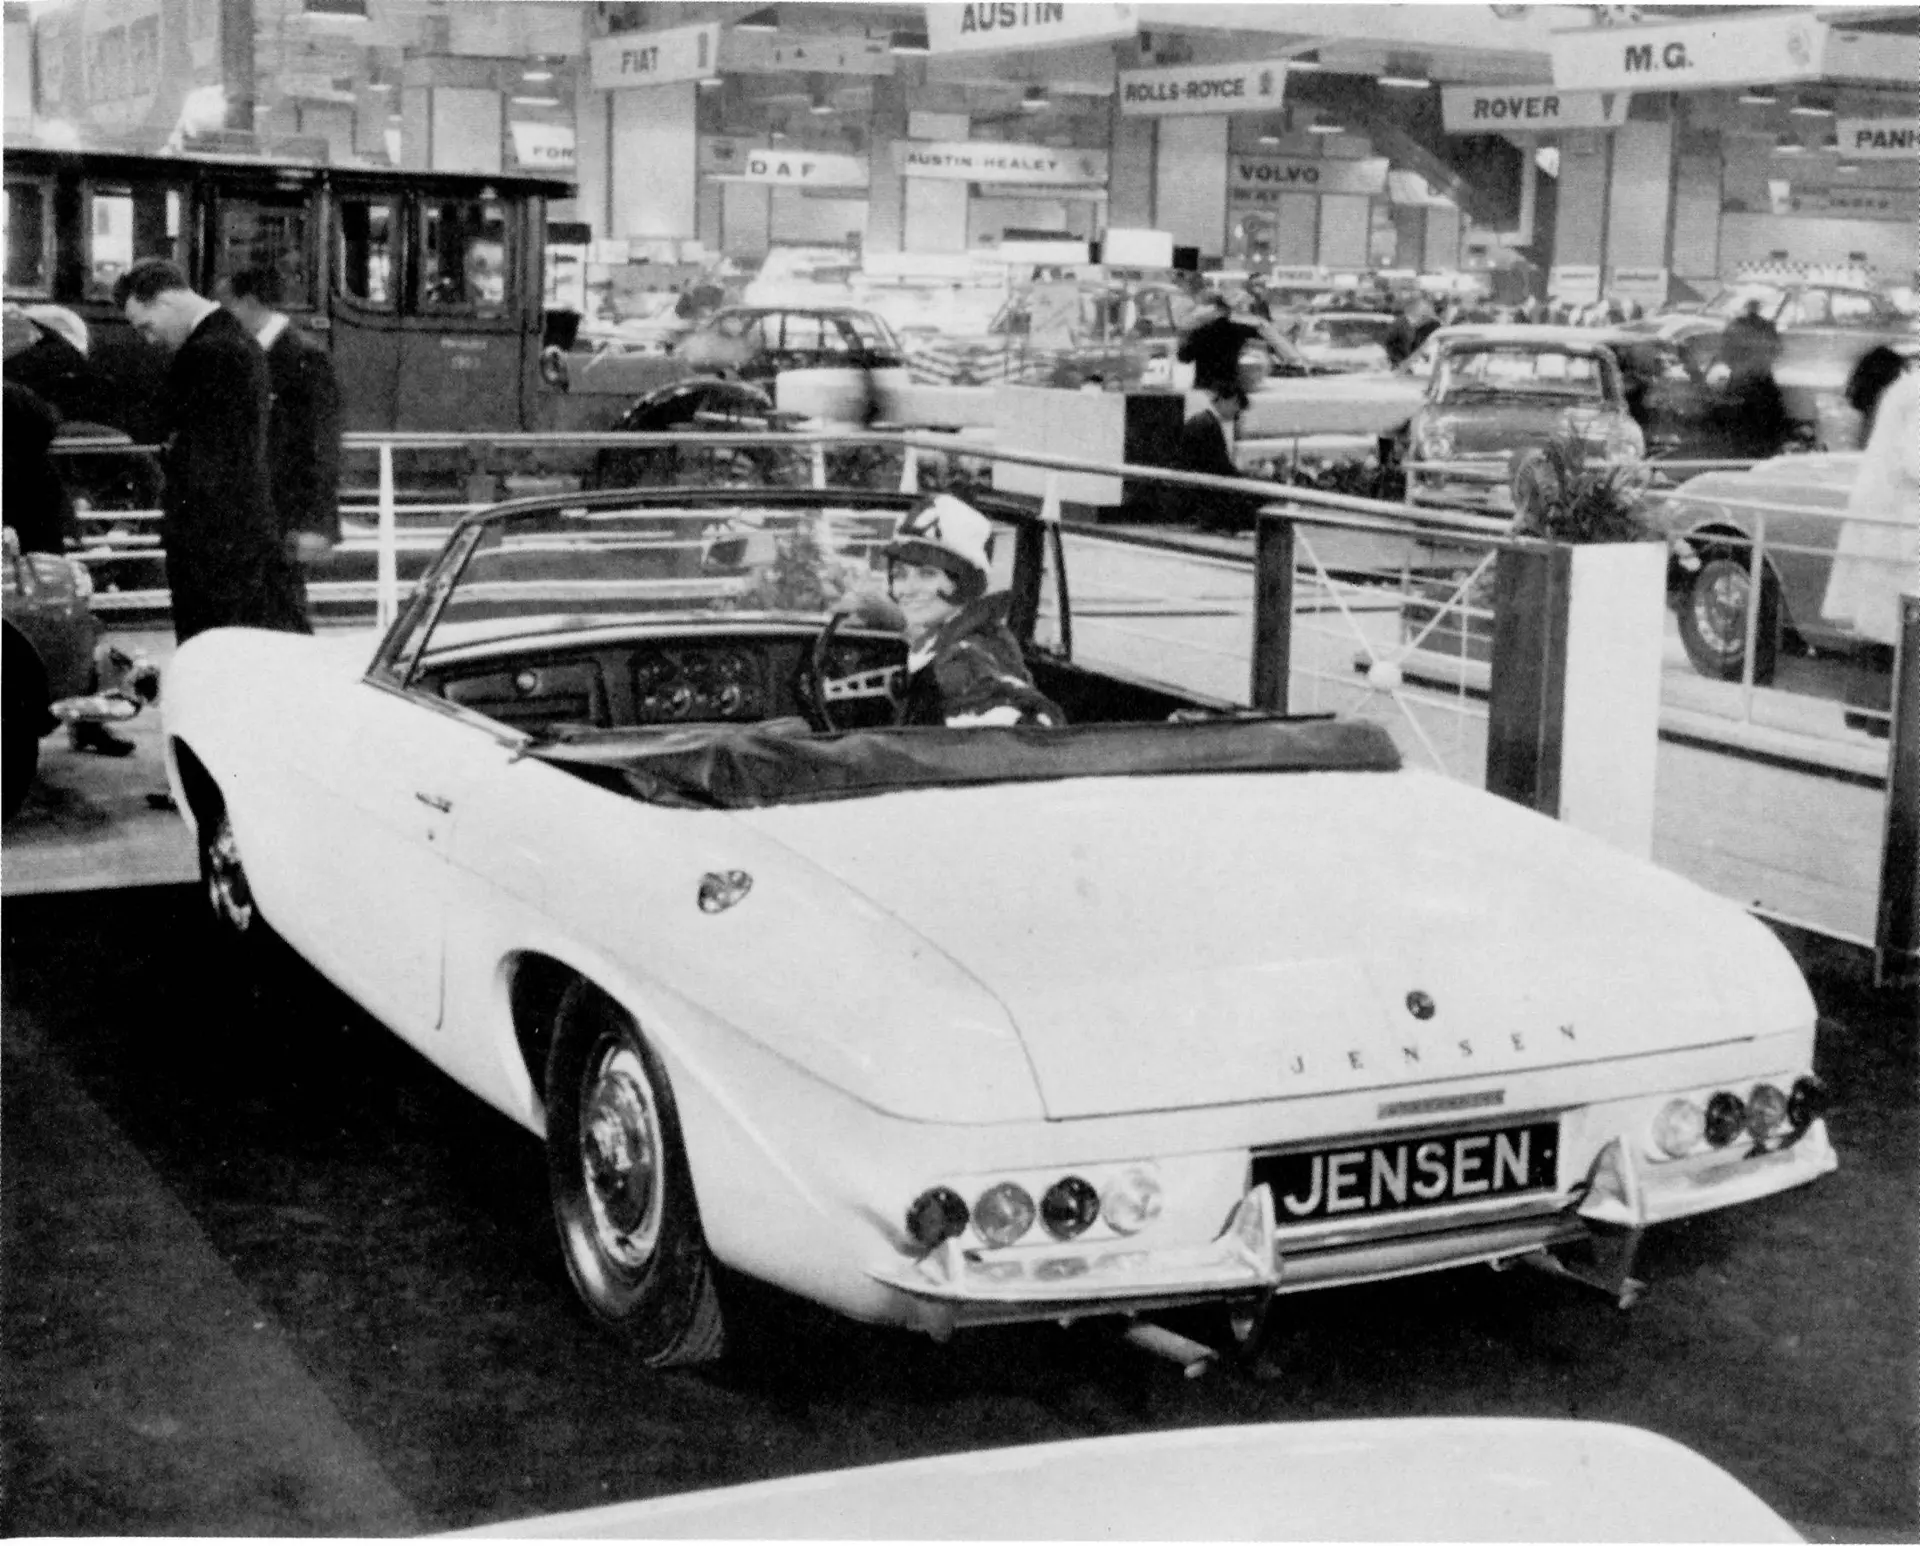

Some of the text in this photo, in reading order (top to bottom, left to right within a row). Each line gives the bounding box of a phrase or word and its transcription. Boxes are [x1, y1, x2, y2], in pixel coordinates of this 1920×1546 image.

[961, 3, 1064, 34] AUSTIN
[621, 46, 658, 74] FIAT
[1624, 42, 1694, 72] M.G.
[1125, 77, 1246, 101] ROLLS-ROYCE
[1473, 96, 1561, 118] ROVER
[908, 153, 1057, 171] AUSTIN HEALEY
[1239, 164, 1319, 183] VOLVO
[1283, 1130, 1531, 1216] JENSEN
